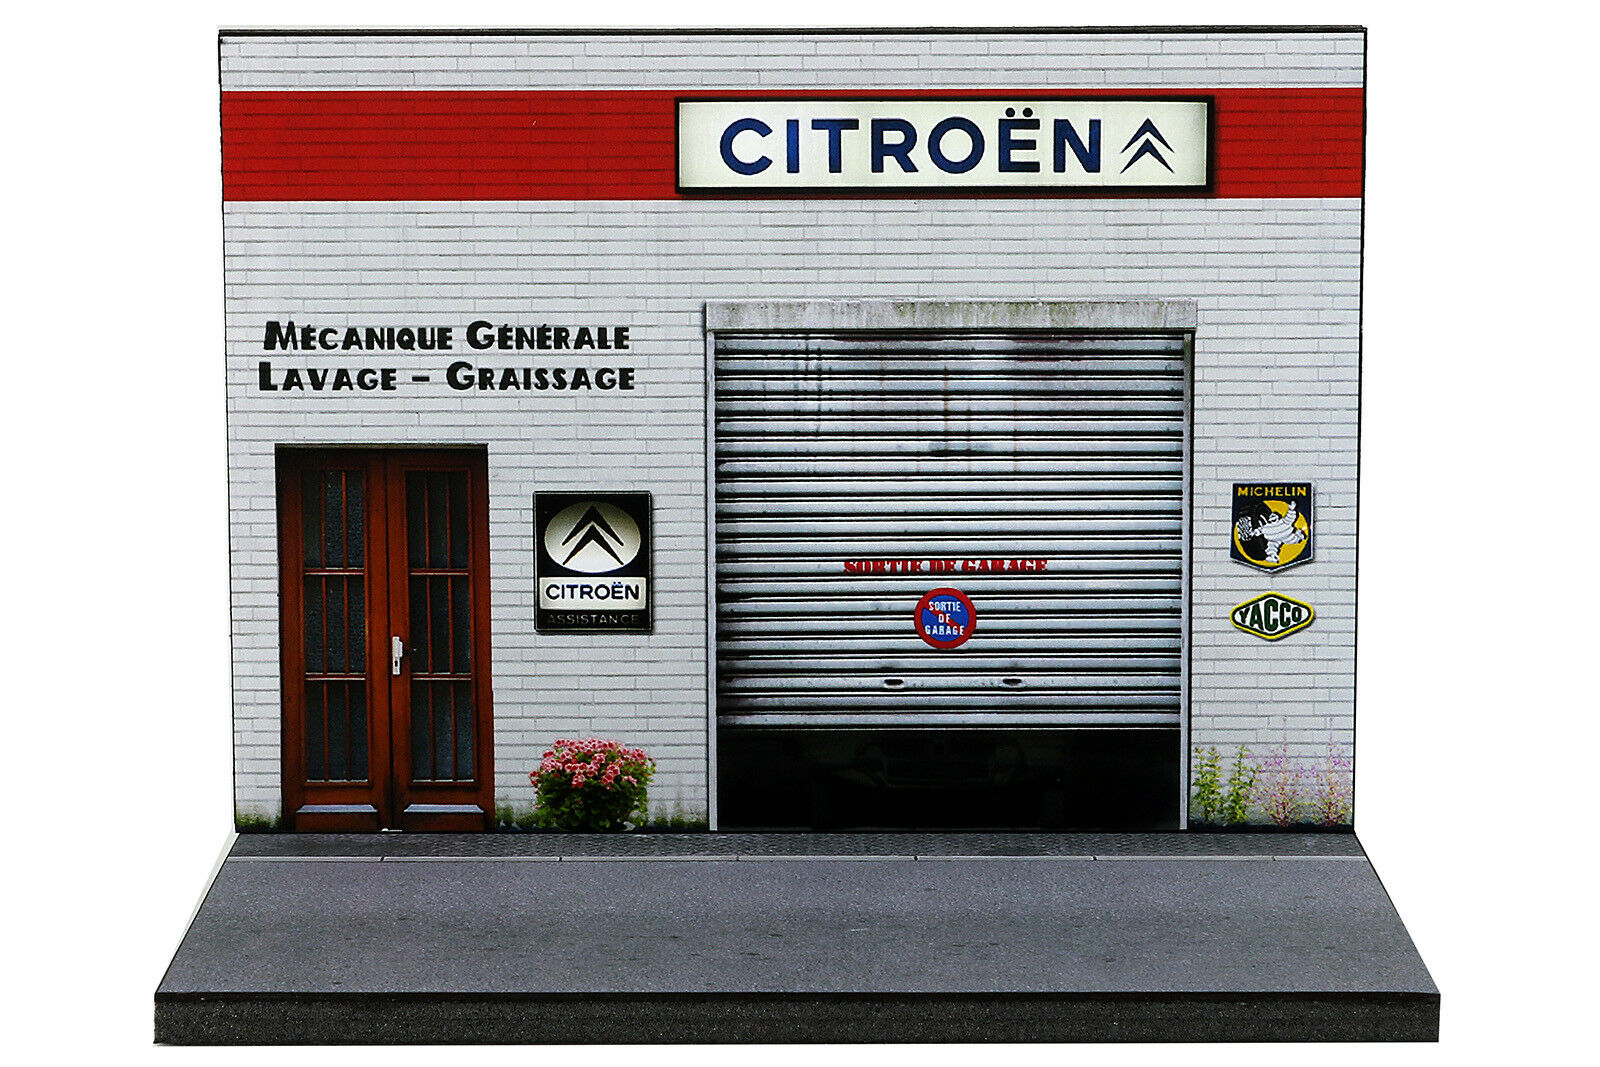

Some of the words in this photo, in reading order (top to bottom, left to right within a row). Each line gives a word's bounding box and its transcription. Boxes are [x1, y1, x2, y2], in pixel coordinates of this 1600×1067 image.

[720, 107, 1102, 176] CITROËN
[258, 361, 397, 391] LAVAGE
[446, 361, 635, 391] GRAISSAGE
[1237, 486, 1306, 497] MICHELIN
[843, 560, 923, 574] SORTIE
[930, 560, 956, 573] DE
[961, 560, 1048, 573] GARAGE
[545, 581, 640, 600] CITROËN
[928, 601, 961, 612] SORTIE
[546, 614, 640, 624] ASSISTANCE
[938, 613, 951, 624] DE
[1239, 598, 1302, 632] YACCO
